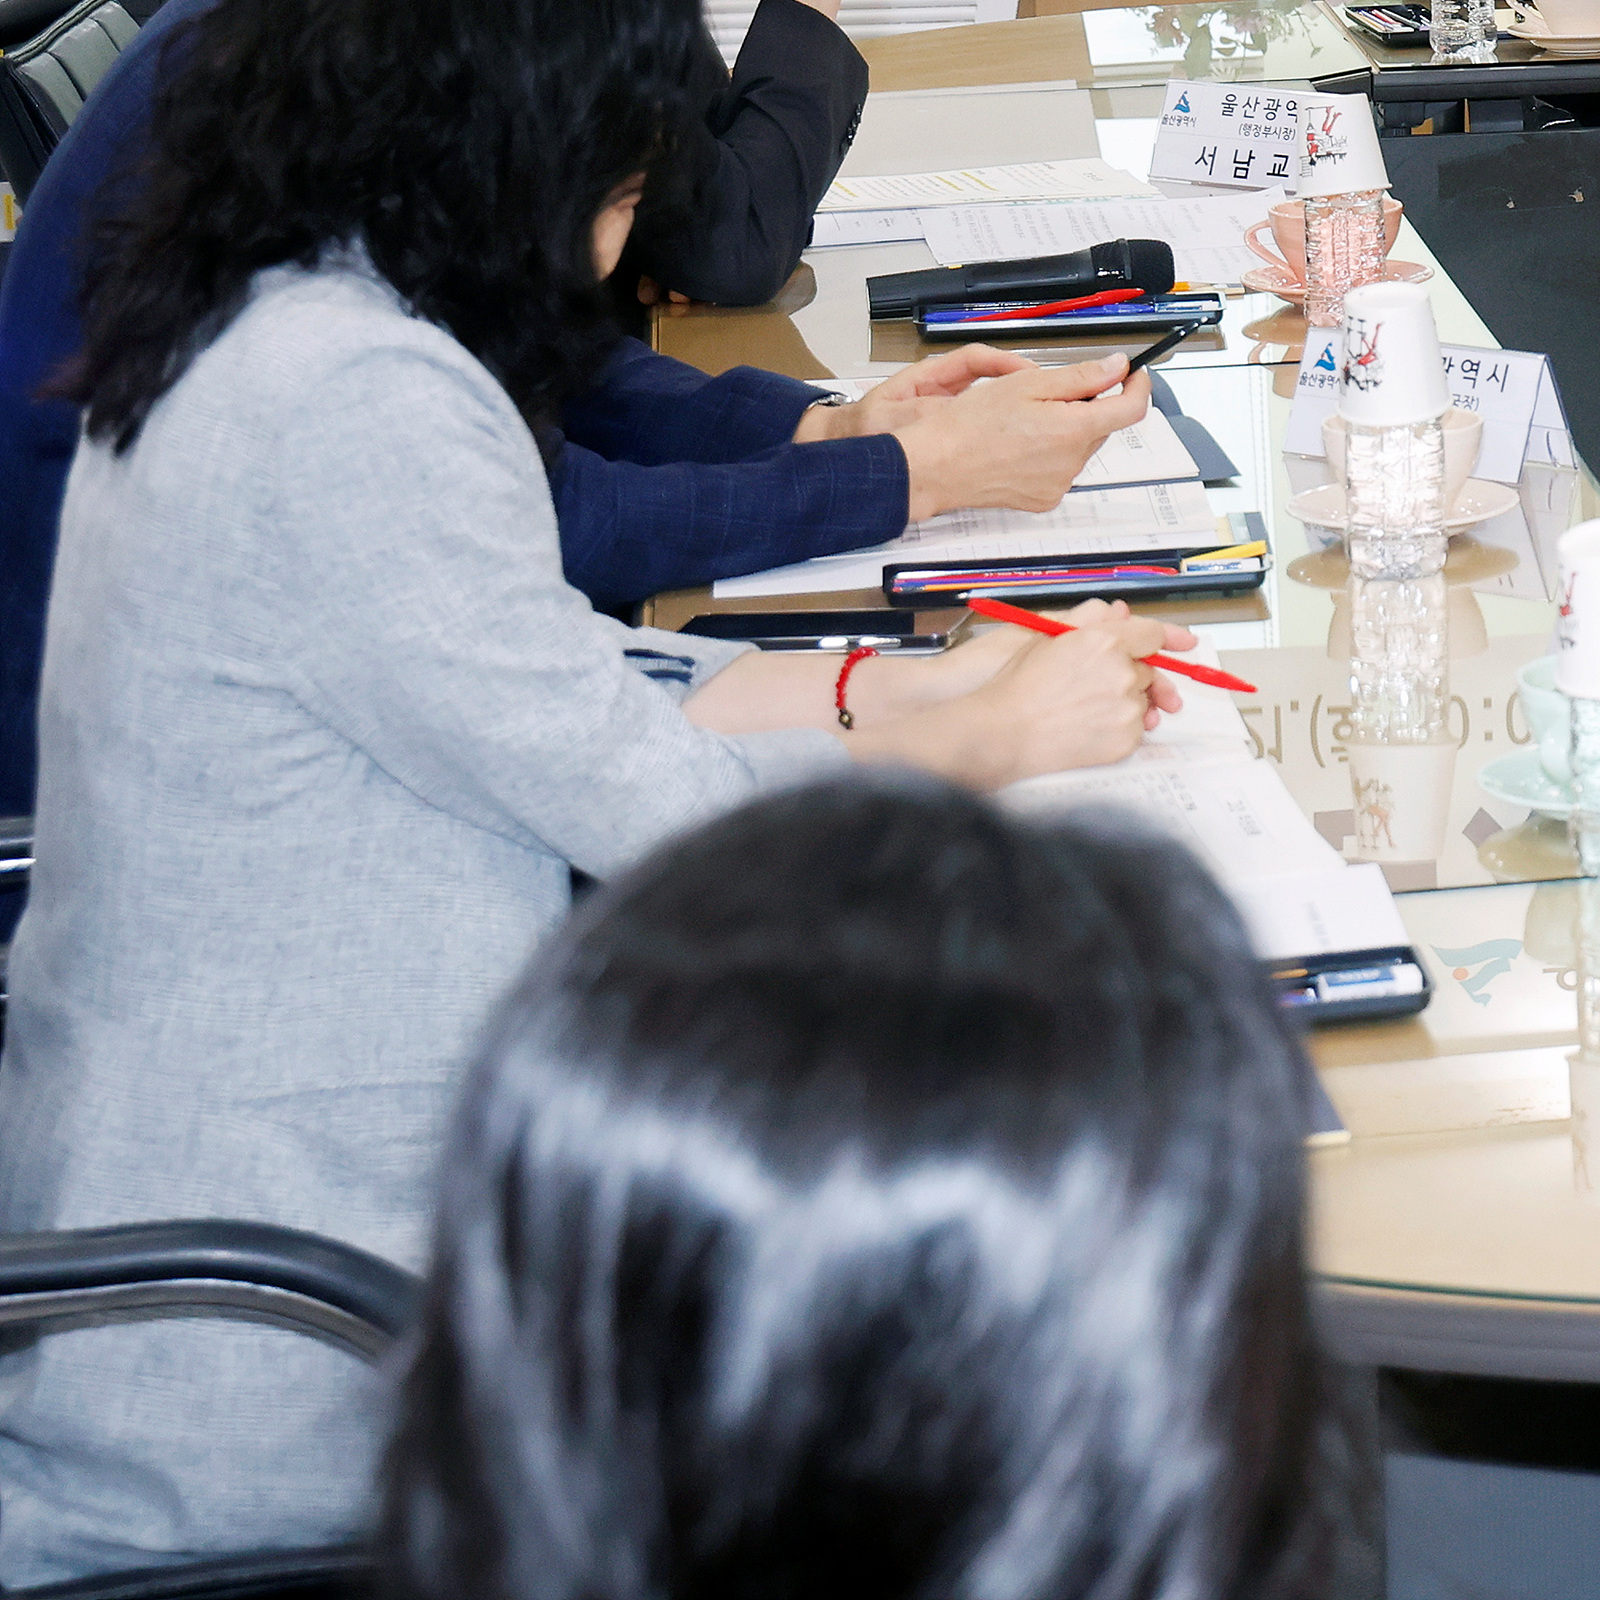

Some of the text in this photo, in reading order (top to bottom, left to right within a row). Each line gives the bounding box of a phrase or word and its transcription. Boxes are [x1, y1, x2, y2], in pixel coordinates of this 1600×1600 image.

[1220, 92, 1298, 124] 울산광역
[1237, 123, 1297, 142] (행정부시장)
[1194, 145, 1291, 180] 서남교
